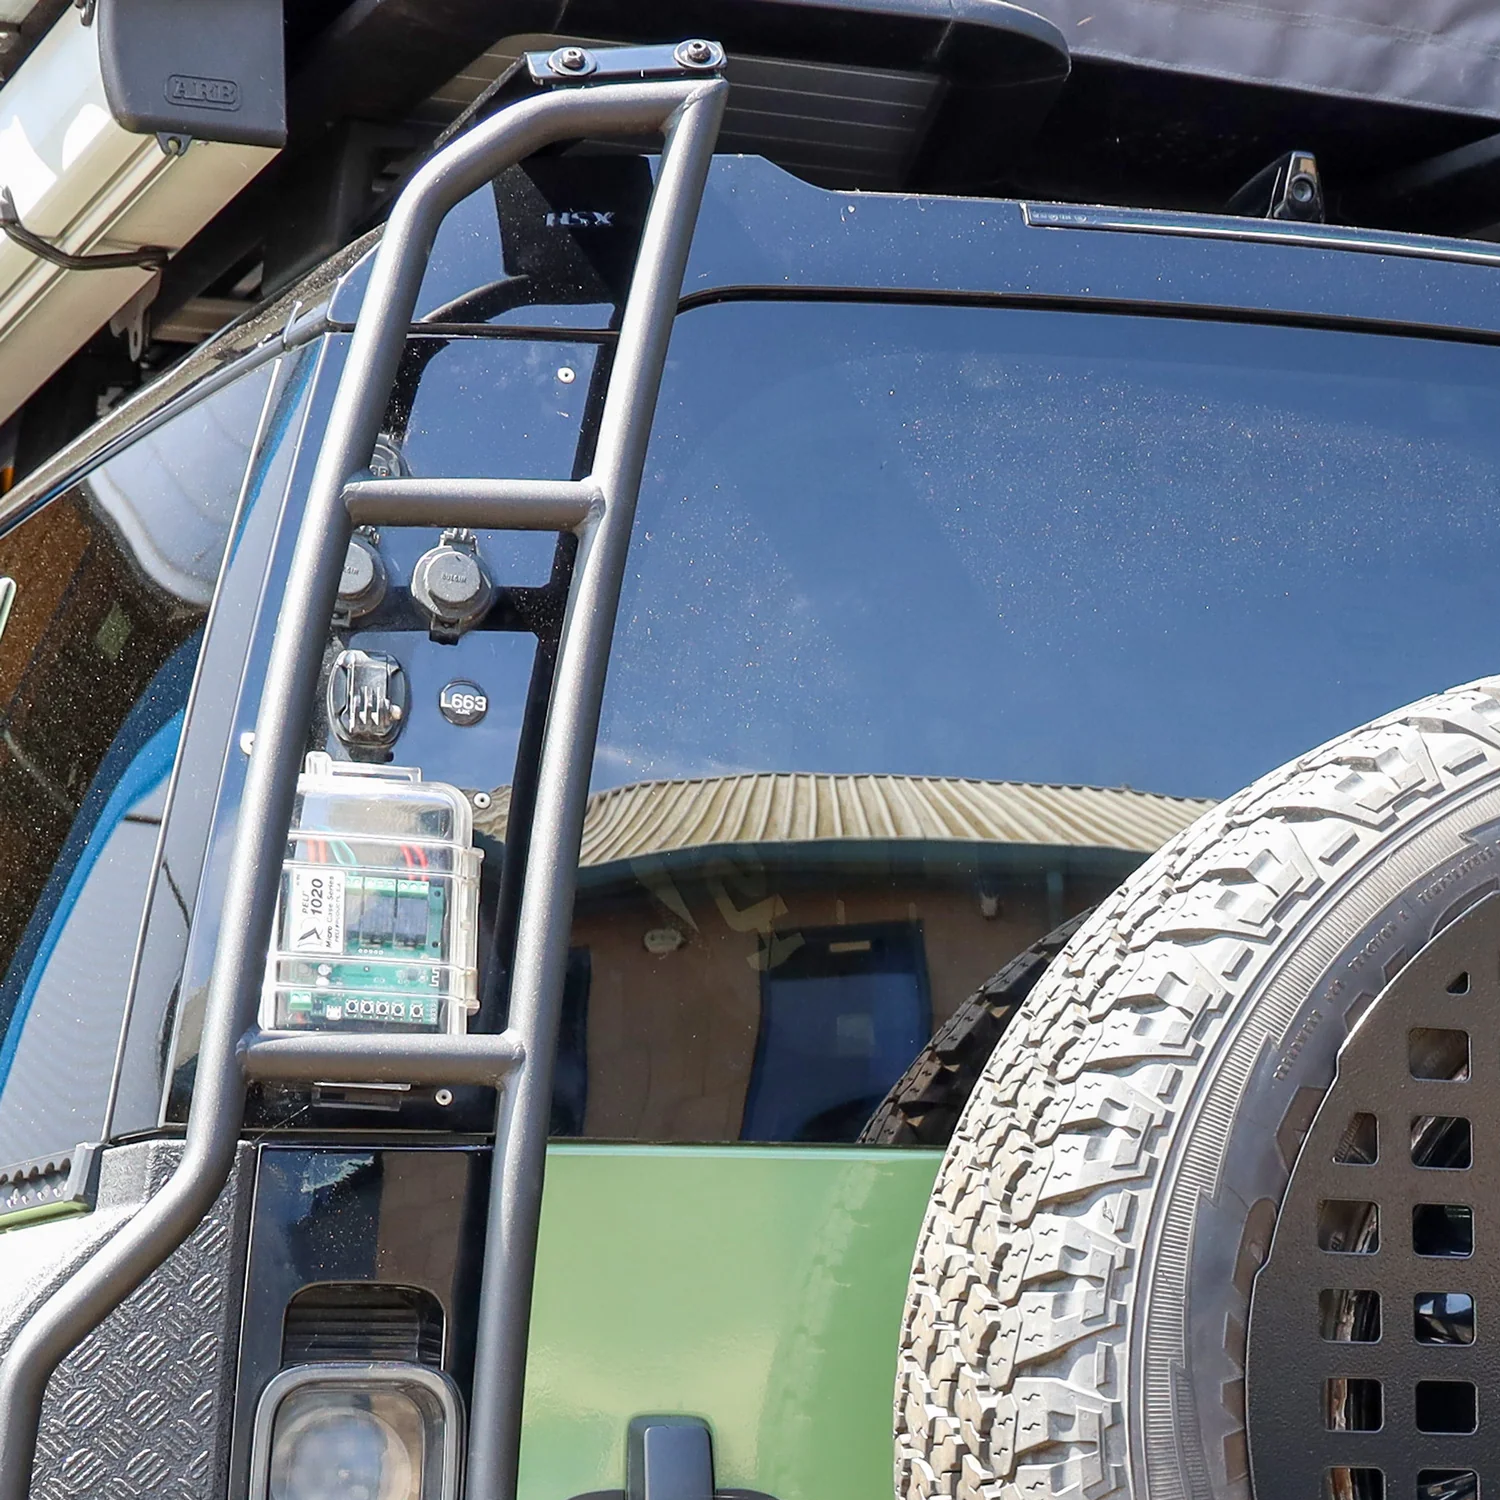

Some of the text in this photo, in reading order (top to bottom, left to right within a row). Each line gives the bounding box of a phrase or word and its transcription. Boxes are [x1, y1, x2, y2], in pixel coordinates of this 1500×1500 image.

[173, 79, 237, 104] ARB
[546, 211, 615, 226] HSX
[440, 691, 487, 712] L663
[310, 878, 323, 915] 1020
[325, 925, 333, 948] Micro
